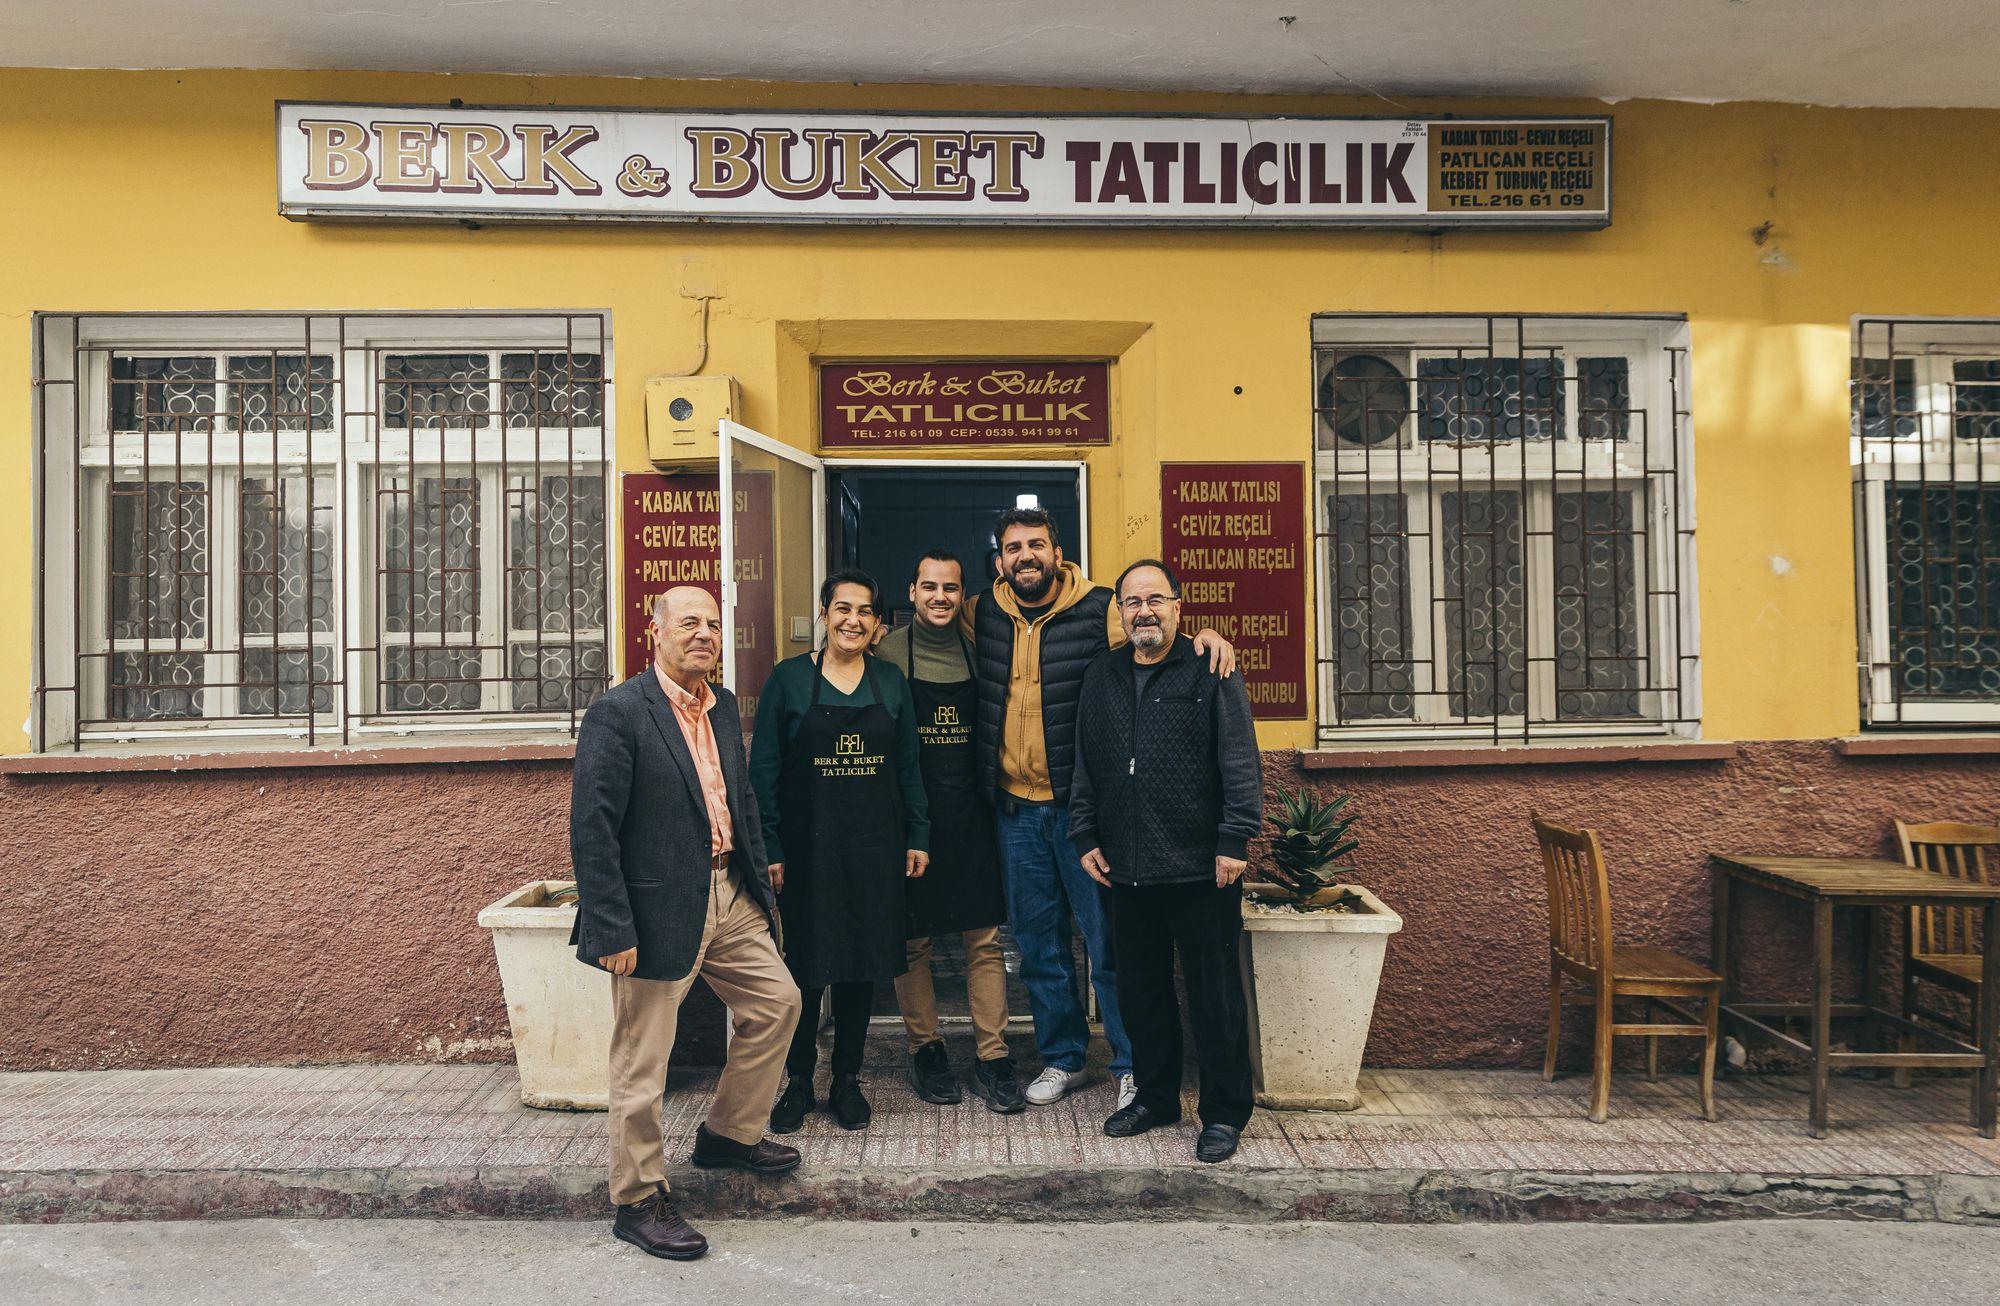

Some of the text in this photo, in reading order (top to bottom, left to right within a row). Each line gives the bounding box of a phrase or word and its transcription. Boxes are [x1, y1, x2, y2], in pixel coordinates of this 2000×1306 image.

[1441, 130, 1478, 145] KABAK
[1479, 130, 1518, 145] TATLISI
[299, 119, 1416, 205] BERK & BUKET TATLICILIK
[1441, 151, 1526, 168] PATLICAN
[1441, 171, 1489, 190] KEBBET
[1495, 171, 1547, 192] TURUNÇ
[1530, 194, 1551, 206] 61
[1560, 194, 1584, 206] 09
[843, 370, 1086, 397] Berk & Buket
[836, 403, 1092, 423] TATLICILIK
[851, 427, 1079, 438] TEL: 216 61 09 CEP: 0539. 941 99 61
[642, 490, 748, 513] KABAK TATSI
[1180, 481, 1281, 502] KABAK TATLISI
[1180, 509, 1271, 541] CEVİZ REÇELİ
[642, 520, 738, 552] CEVİZ REÇİ
[1181, 542, 1295, 574] PATLICAN REÇELİ
[643, 554, 763, 586] PATLICAN RÇELİ
[1181, 582, 1235, 603] KEBBET
[1242, 610, 1289, 641] REÇELİ
[814, 757, 839, 765] BERK
[853, 755, 885, 765] BUKET
[821, 766, 876, 776] TATLICILIK
